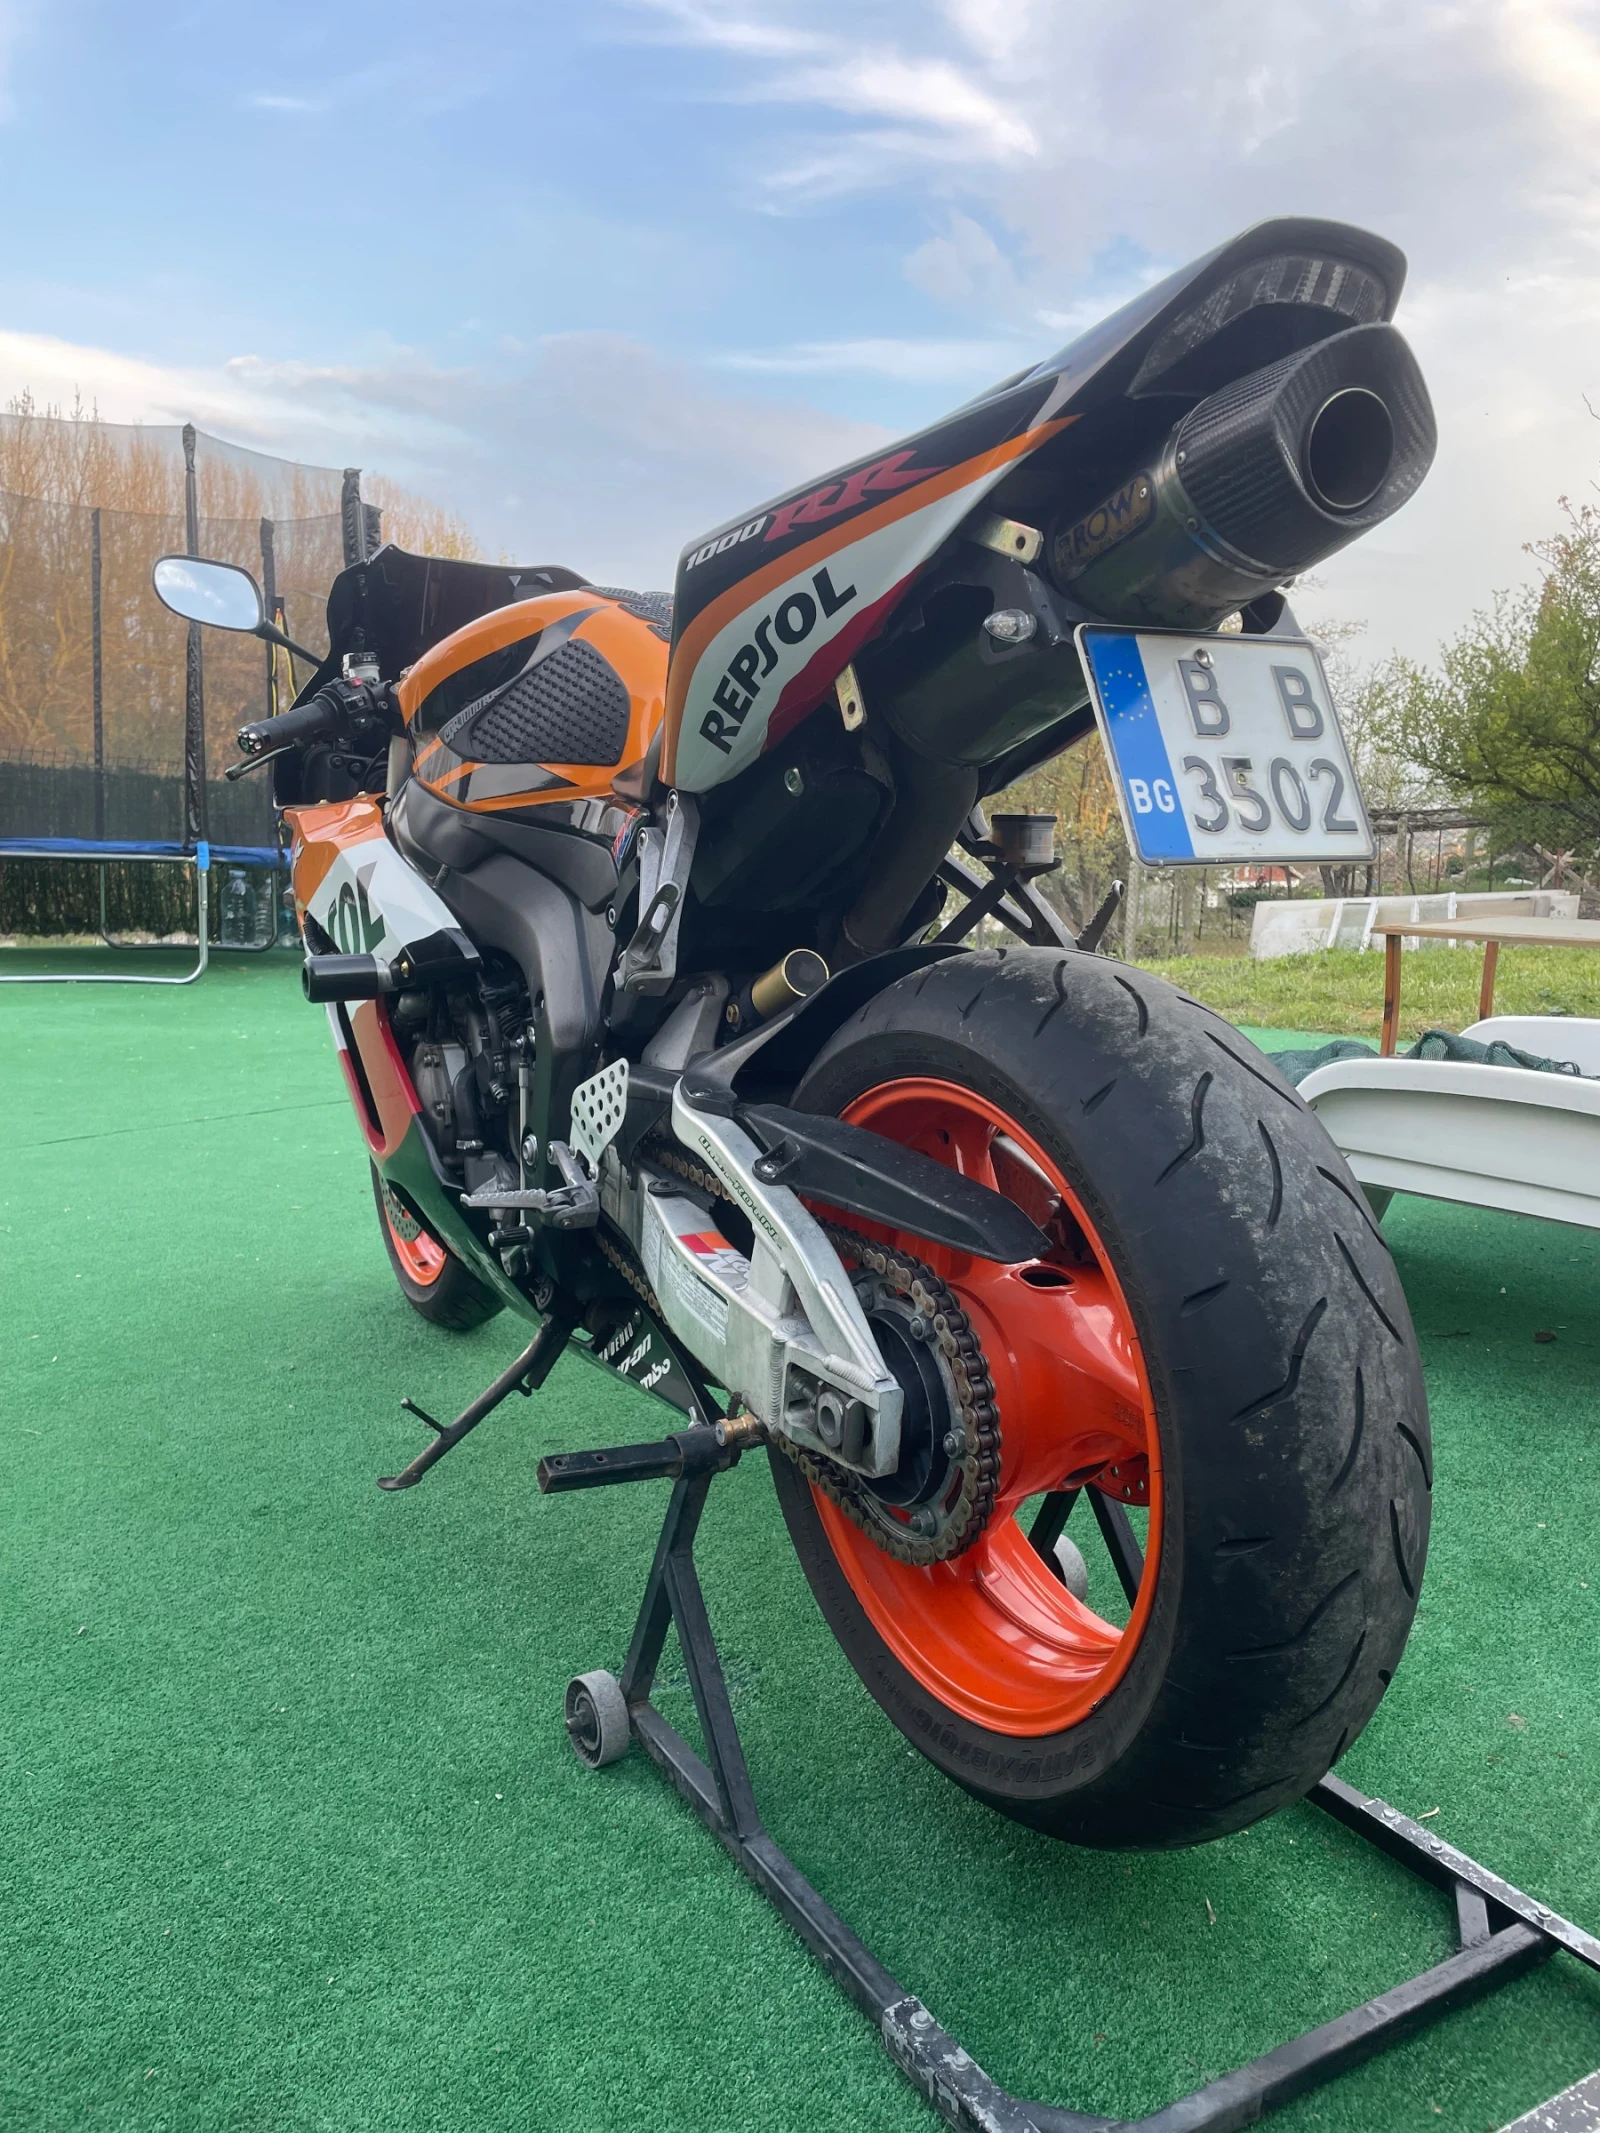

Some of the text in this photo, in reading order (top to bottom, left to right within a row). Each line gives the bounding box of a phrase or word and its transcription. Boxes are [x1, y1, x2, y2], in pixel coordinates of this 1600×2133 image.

[699, 566, 858, 755] REPSOL
[1128, 779, 1175, 814] BG
[1183, 755, 1358, 833] 3502
